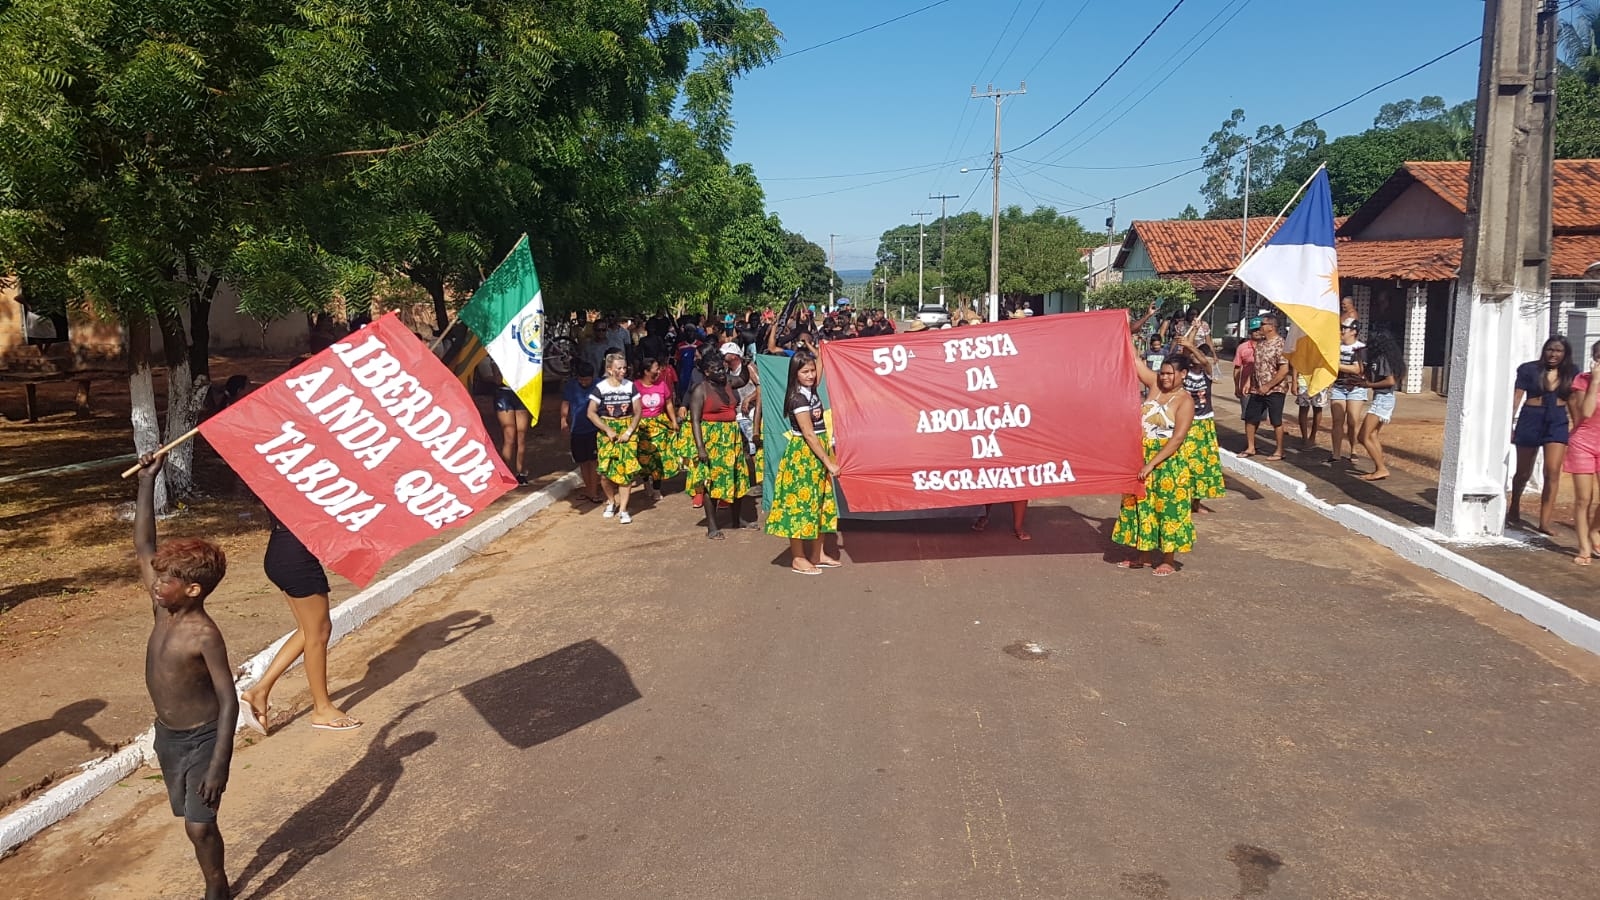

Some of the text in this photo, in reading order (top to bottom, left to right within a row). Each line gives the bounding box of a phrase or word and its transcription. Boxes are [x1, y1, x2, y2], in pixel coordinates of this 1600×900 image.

[943, 333, 1019, 363] FESTA
[965, 365, 998, 392] DA
[916, 402, 1032, 434] ABOLIÇÃO
[286, 366, 474, 530] AINDA QUE
[254, 421, 387, 532] TARDIA
[911, 459, 1076, 491] ESCRAVATURA
